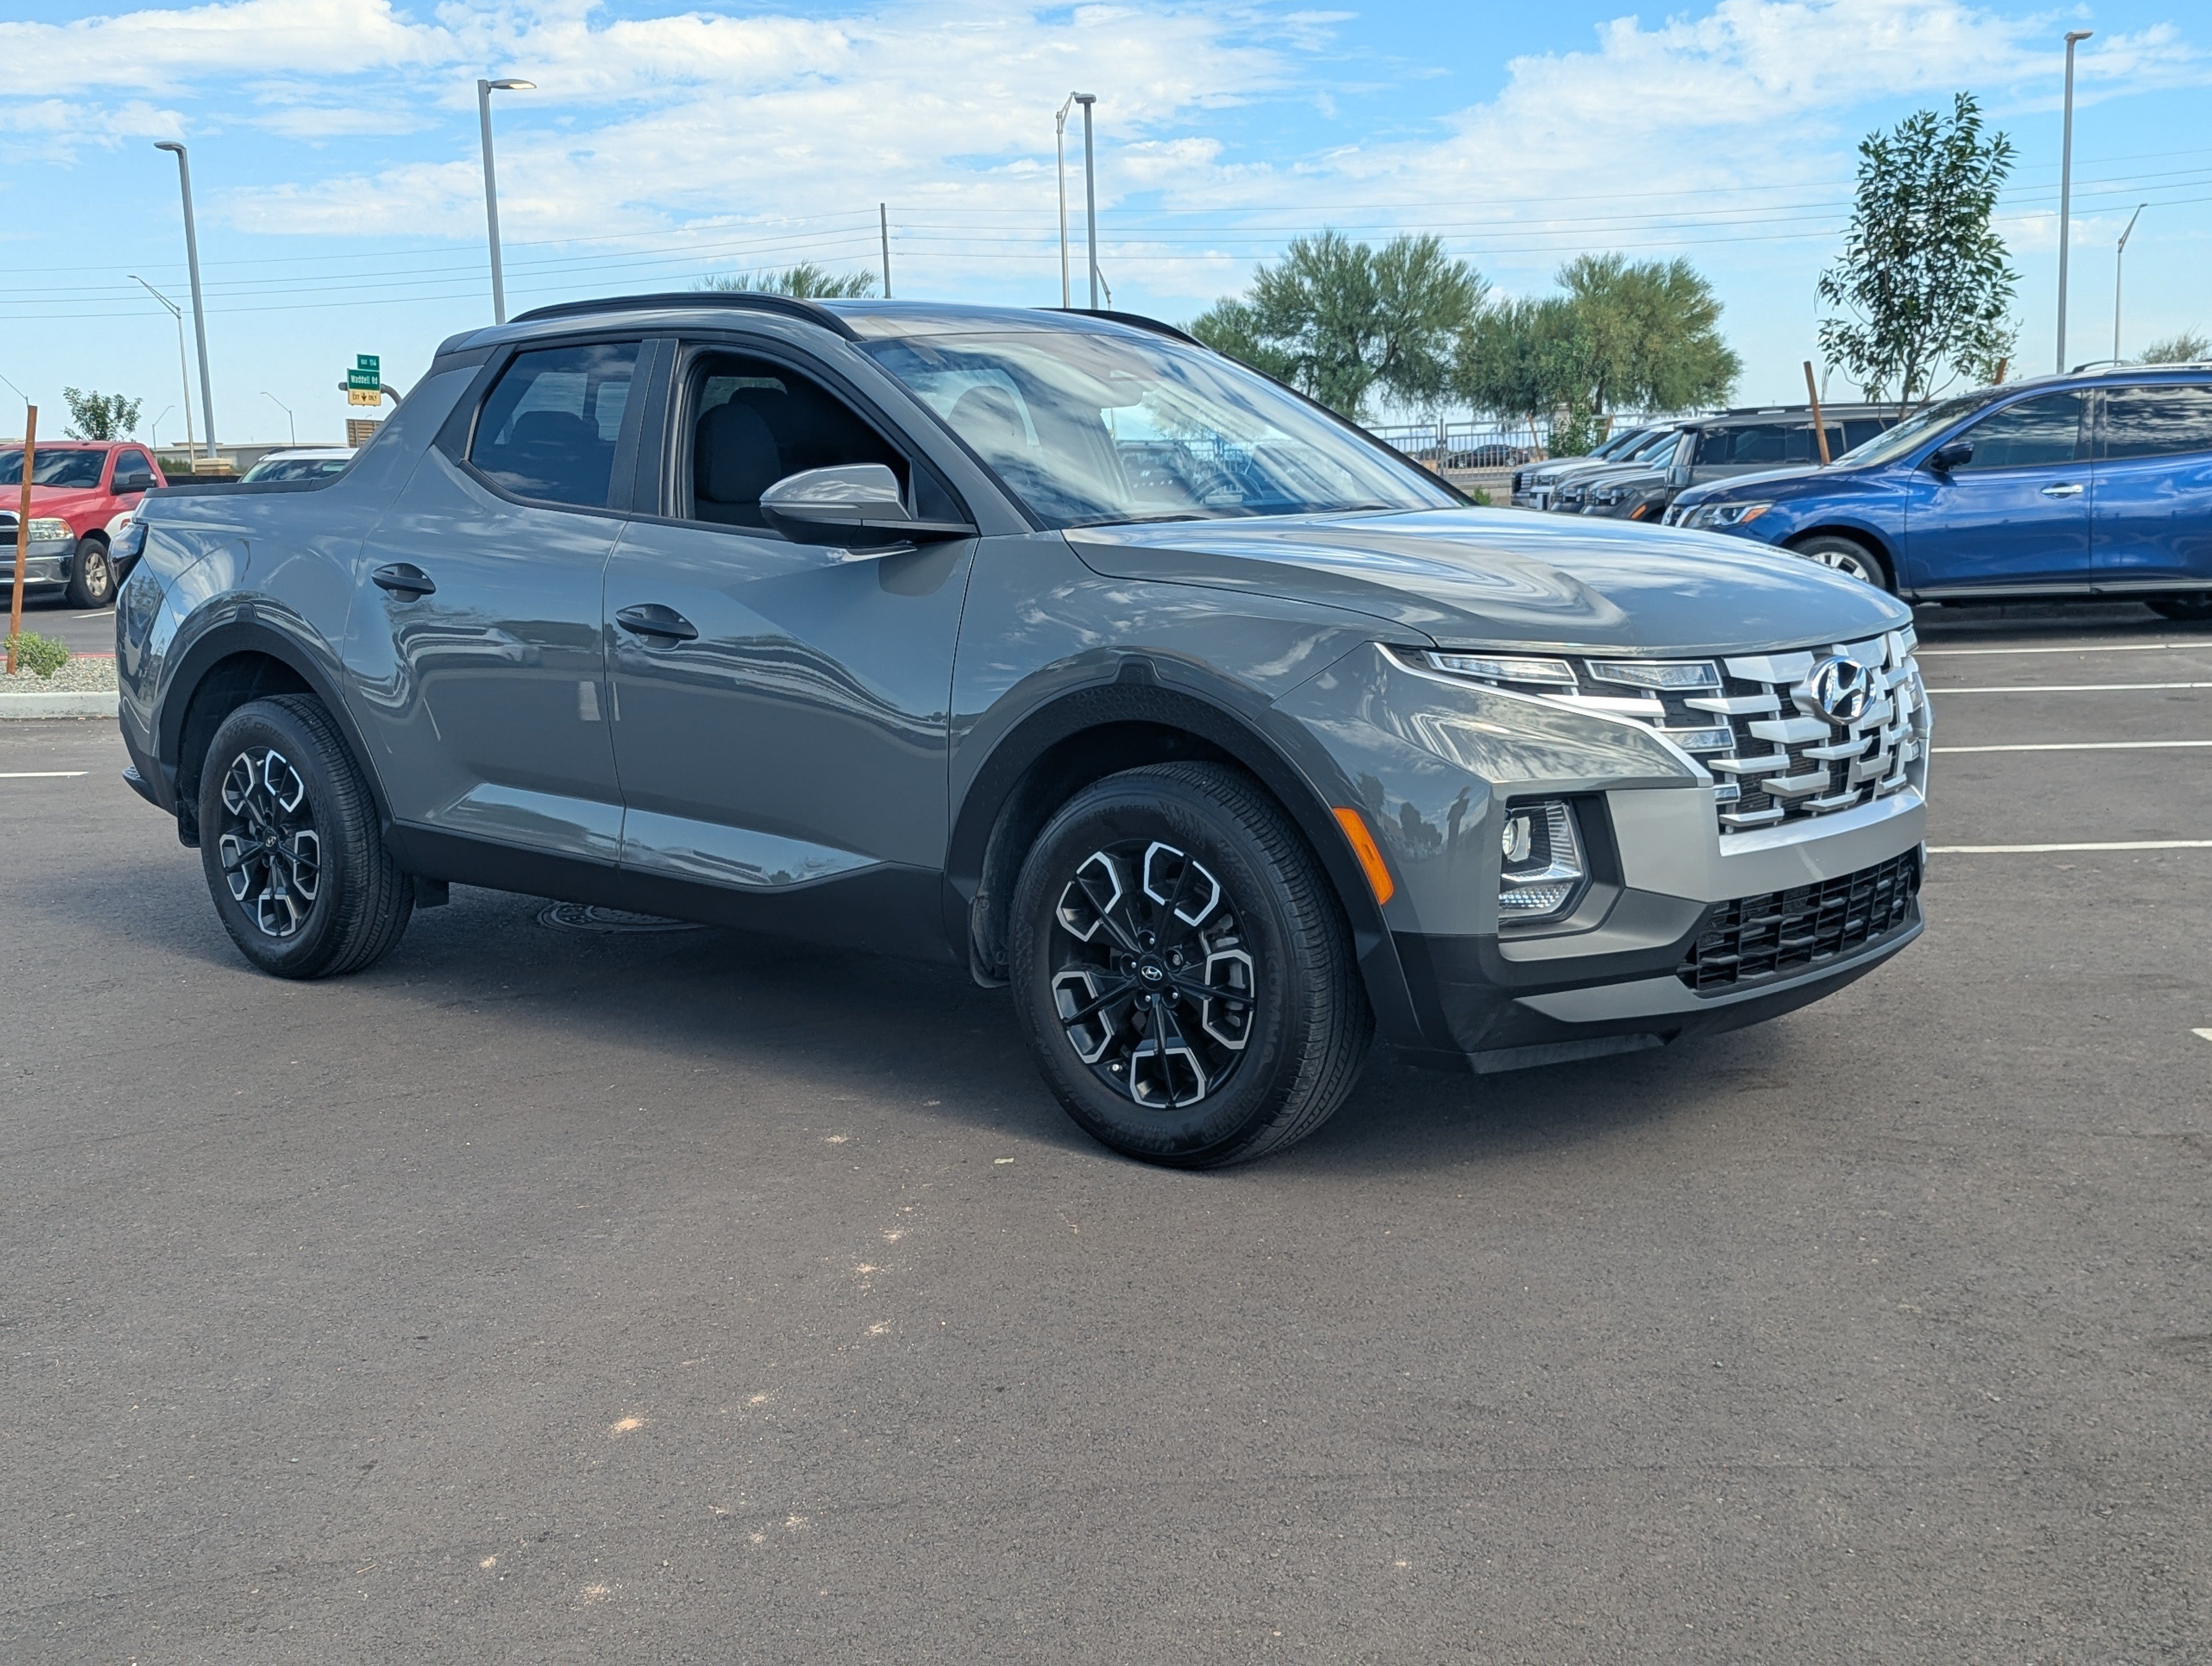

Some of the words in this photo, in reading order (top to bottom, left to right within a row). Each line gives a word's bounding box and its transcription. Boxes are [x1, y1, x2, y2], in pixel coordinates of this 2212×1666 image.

[351, 375, 370, 384] Waddell
[371, 376, 378, 385] Rd
[1262, 950, 1282, 1066] KUMHO
